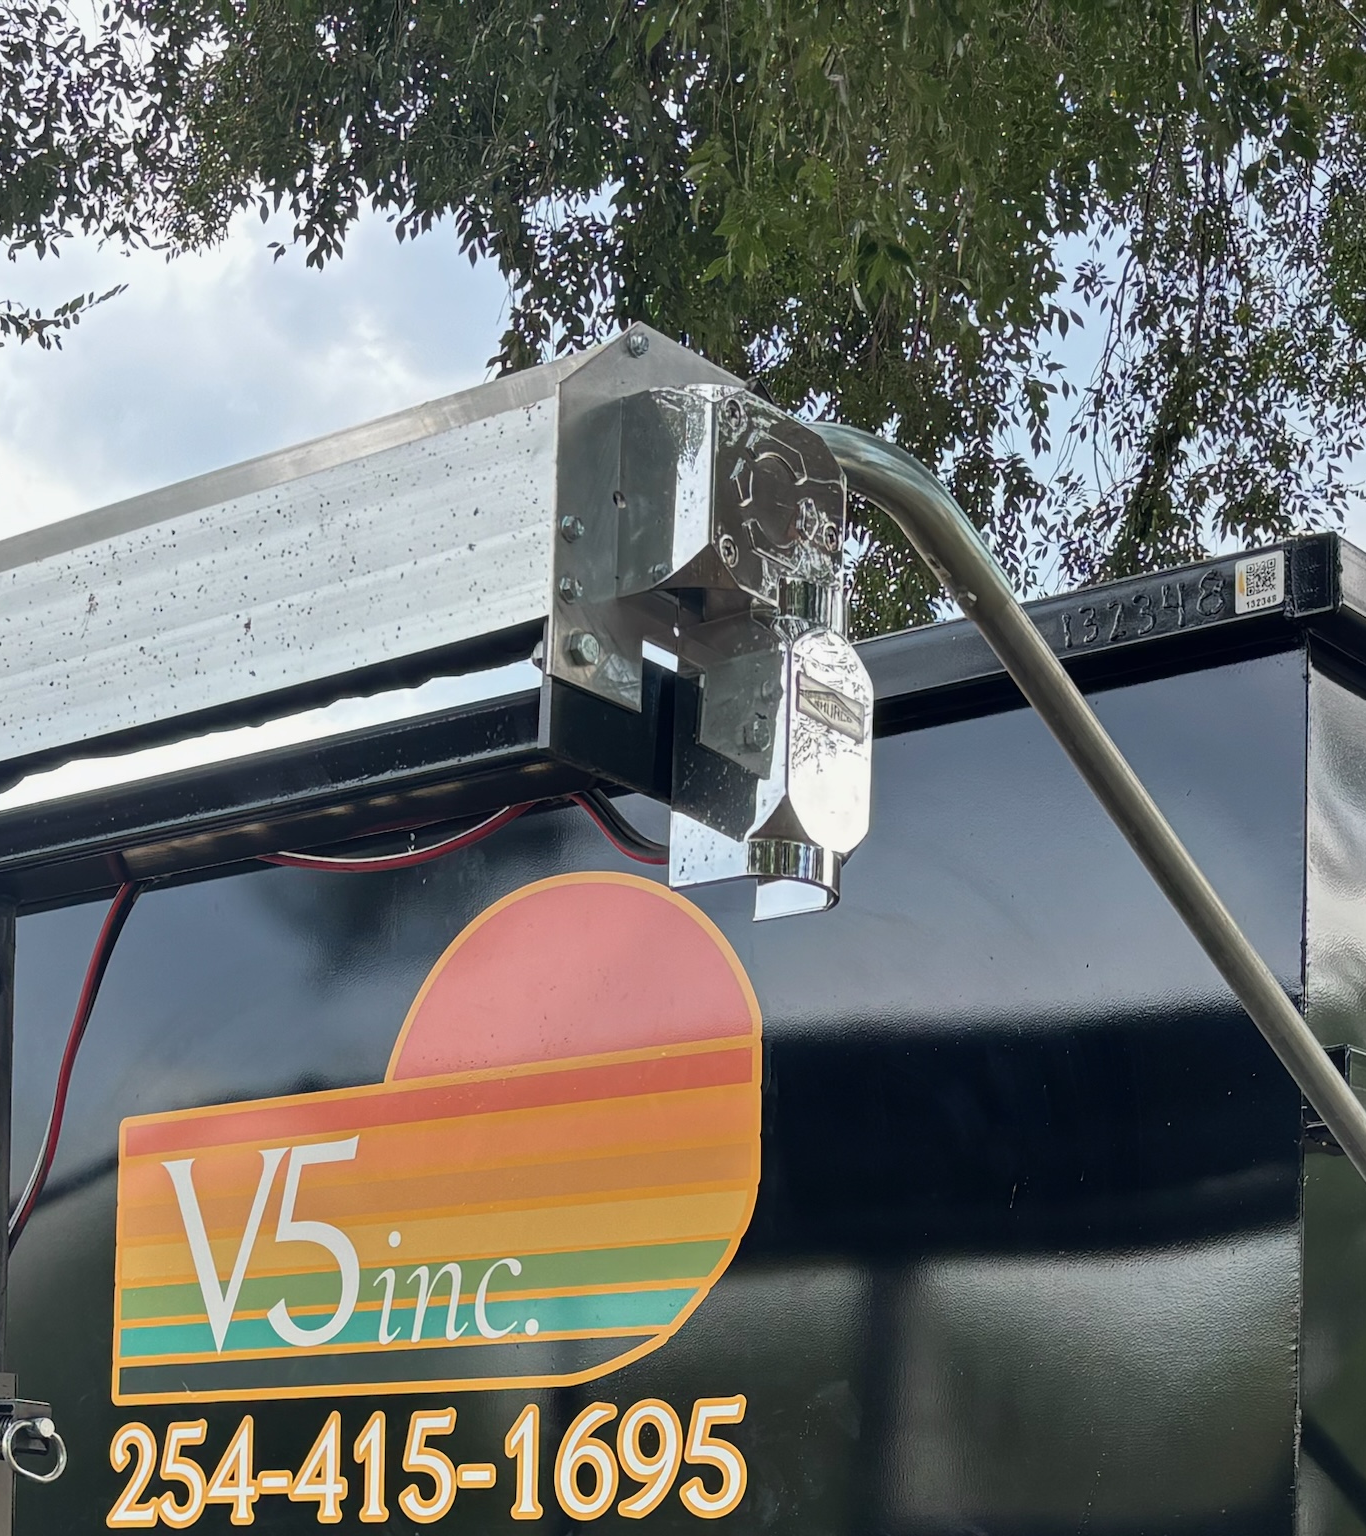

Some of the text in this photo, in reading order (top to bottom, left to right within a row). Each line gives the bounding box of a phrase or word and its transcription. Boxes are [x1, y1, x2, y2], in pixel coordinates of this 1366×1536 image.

[1060, 568, 1228, 650] 132348
[160, 1134, 541, 1356] V5 inc.
[107, 1393, 747, 1530] 254-415-1695
